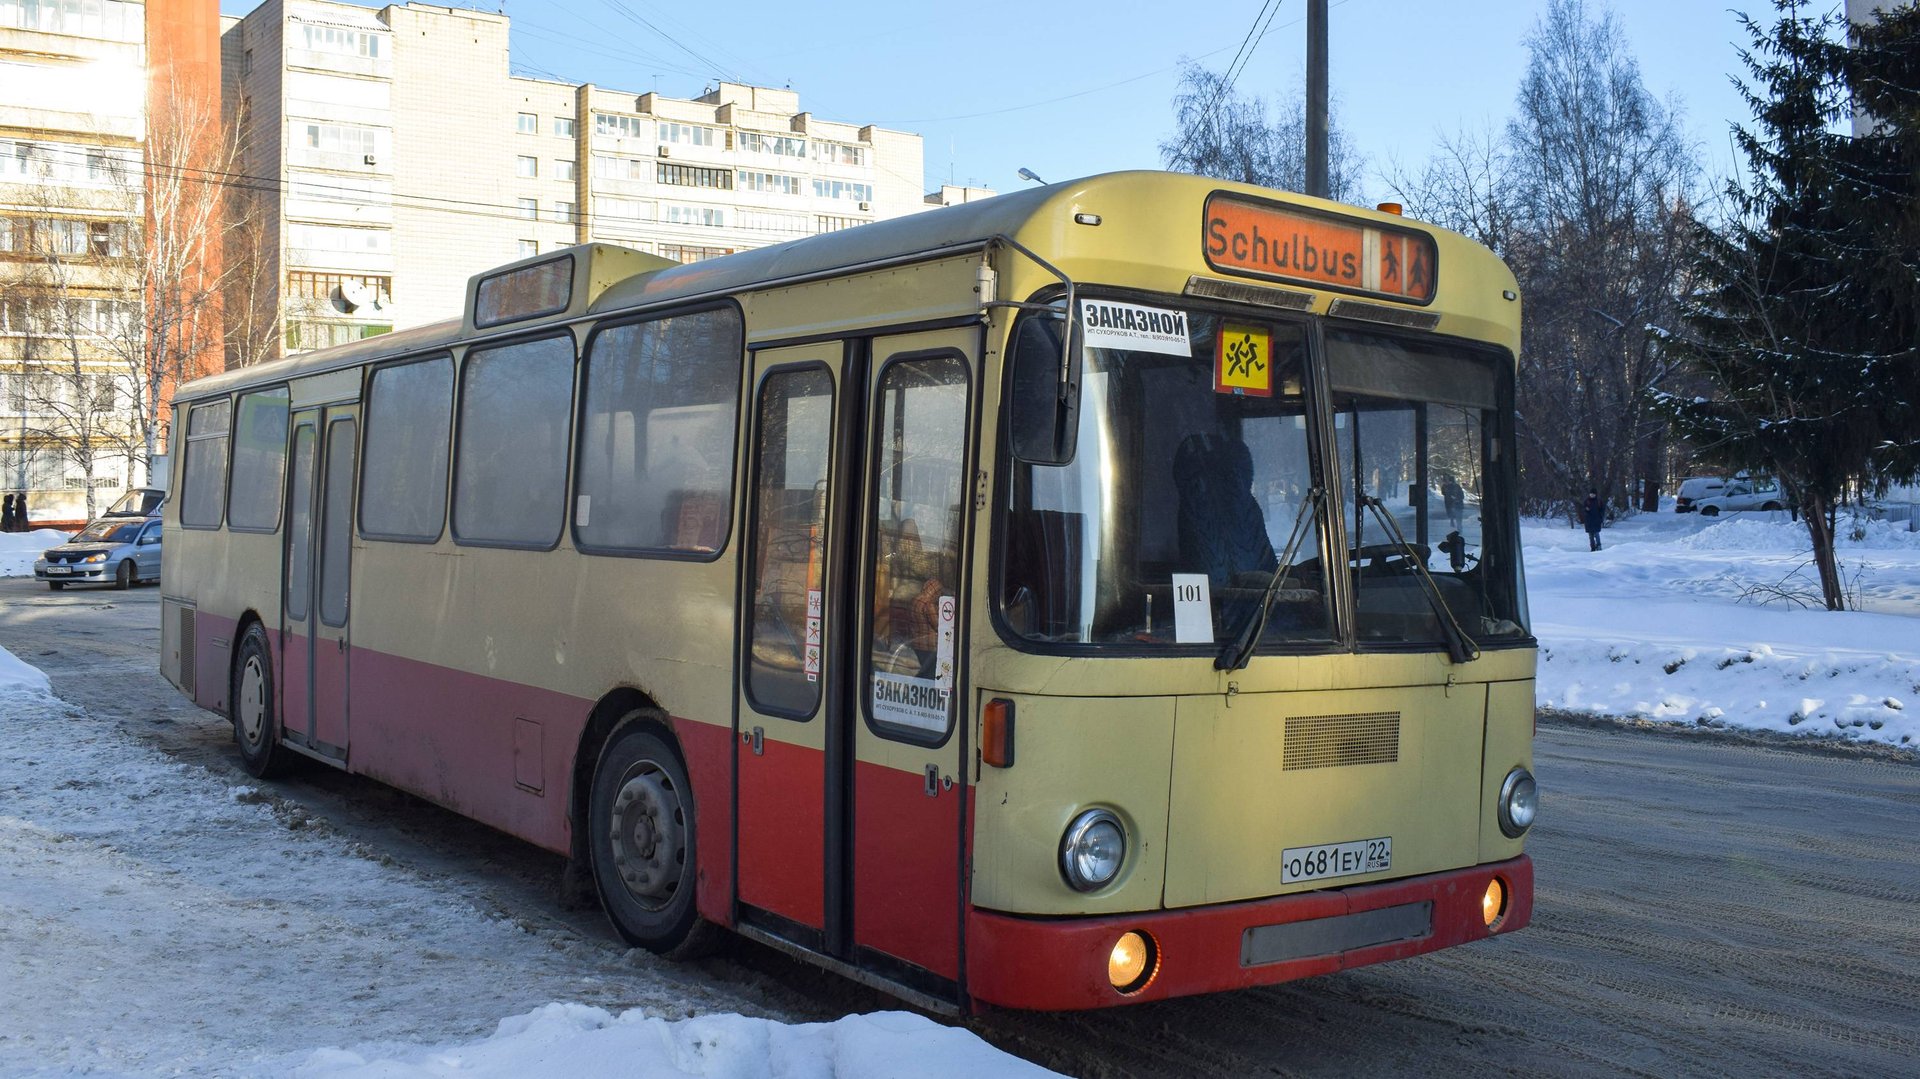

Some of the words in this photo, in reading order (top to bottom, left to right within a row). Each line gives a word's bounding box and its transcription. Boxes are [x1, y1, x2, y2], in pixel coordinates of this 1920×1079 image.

[1208, 218, 1356, 278] Schulbus
[1086, 304, 1185, 336] ЗАКАЗНОЙ
[1177, 584, 1202, 602] 101
[1369, 841, 1385, 860] 22
